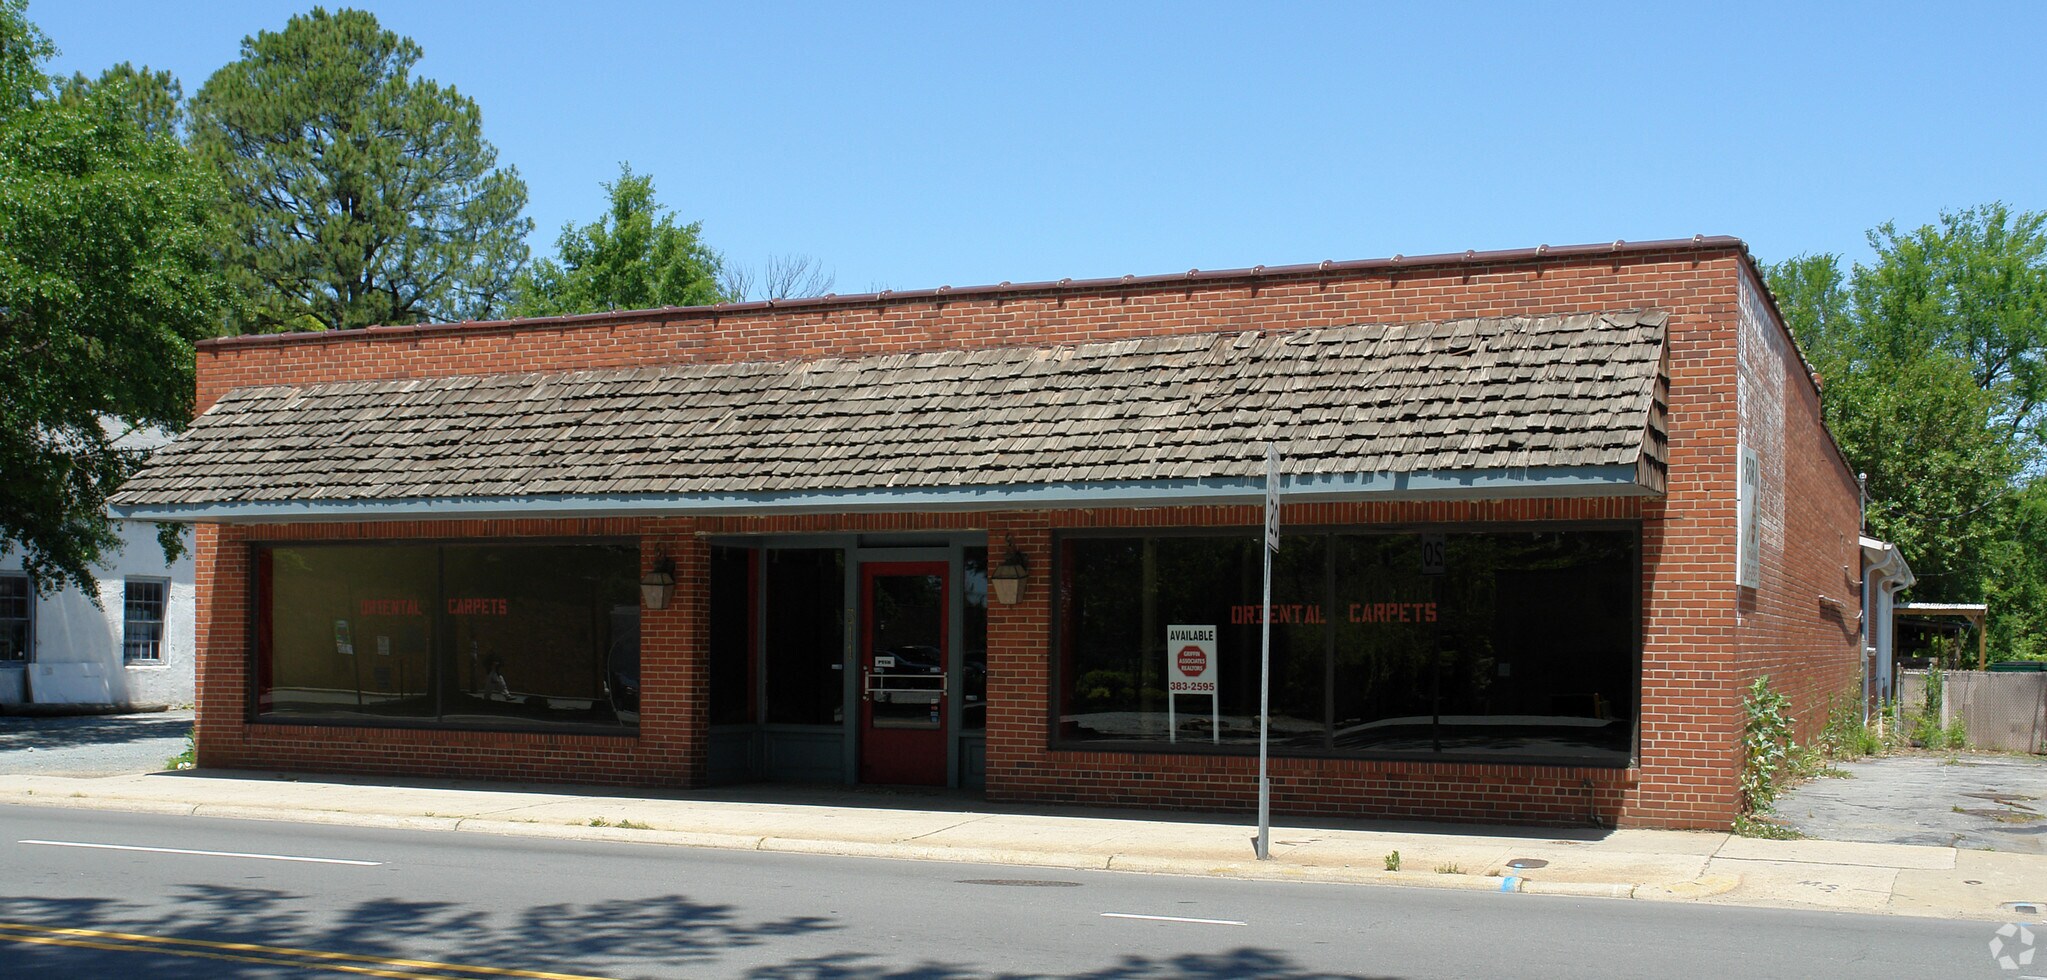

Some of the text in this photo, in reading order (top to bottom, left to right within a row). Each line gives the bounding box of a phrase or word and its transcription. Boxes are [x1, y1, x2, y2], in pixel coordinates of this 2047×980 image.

[1269, 498, 1279, 538] 20
[360, 598, 507, 616] ORIENTAL CARPETS
[1231, 602, 1438, 624] ORIENTAL CARPETS
[1170, 630, 1214, 641] AVAILABLE
[1170, 682, 1215, 691] 383-2595
